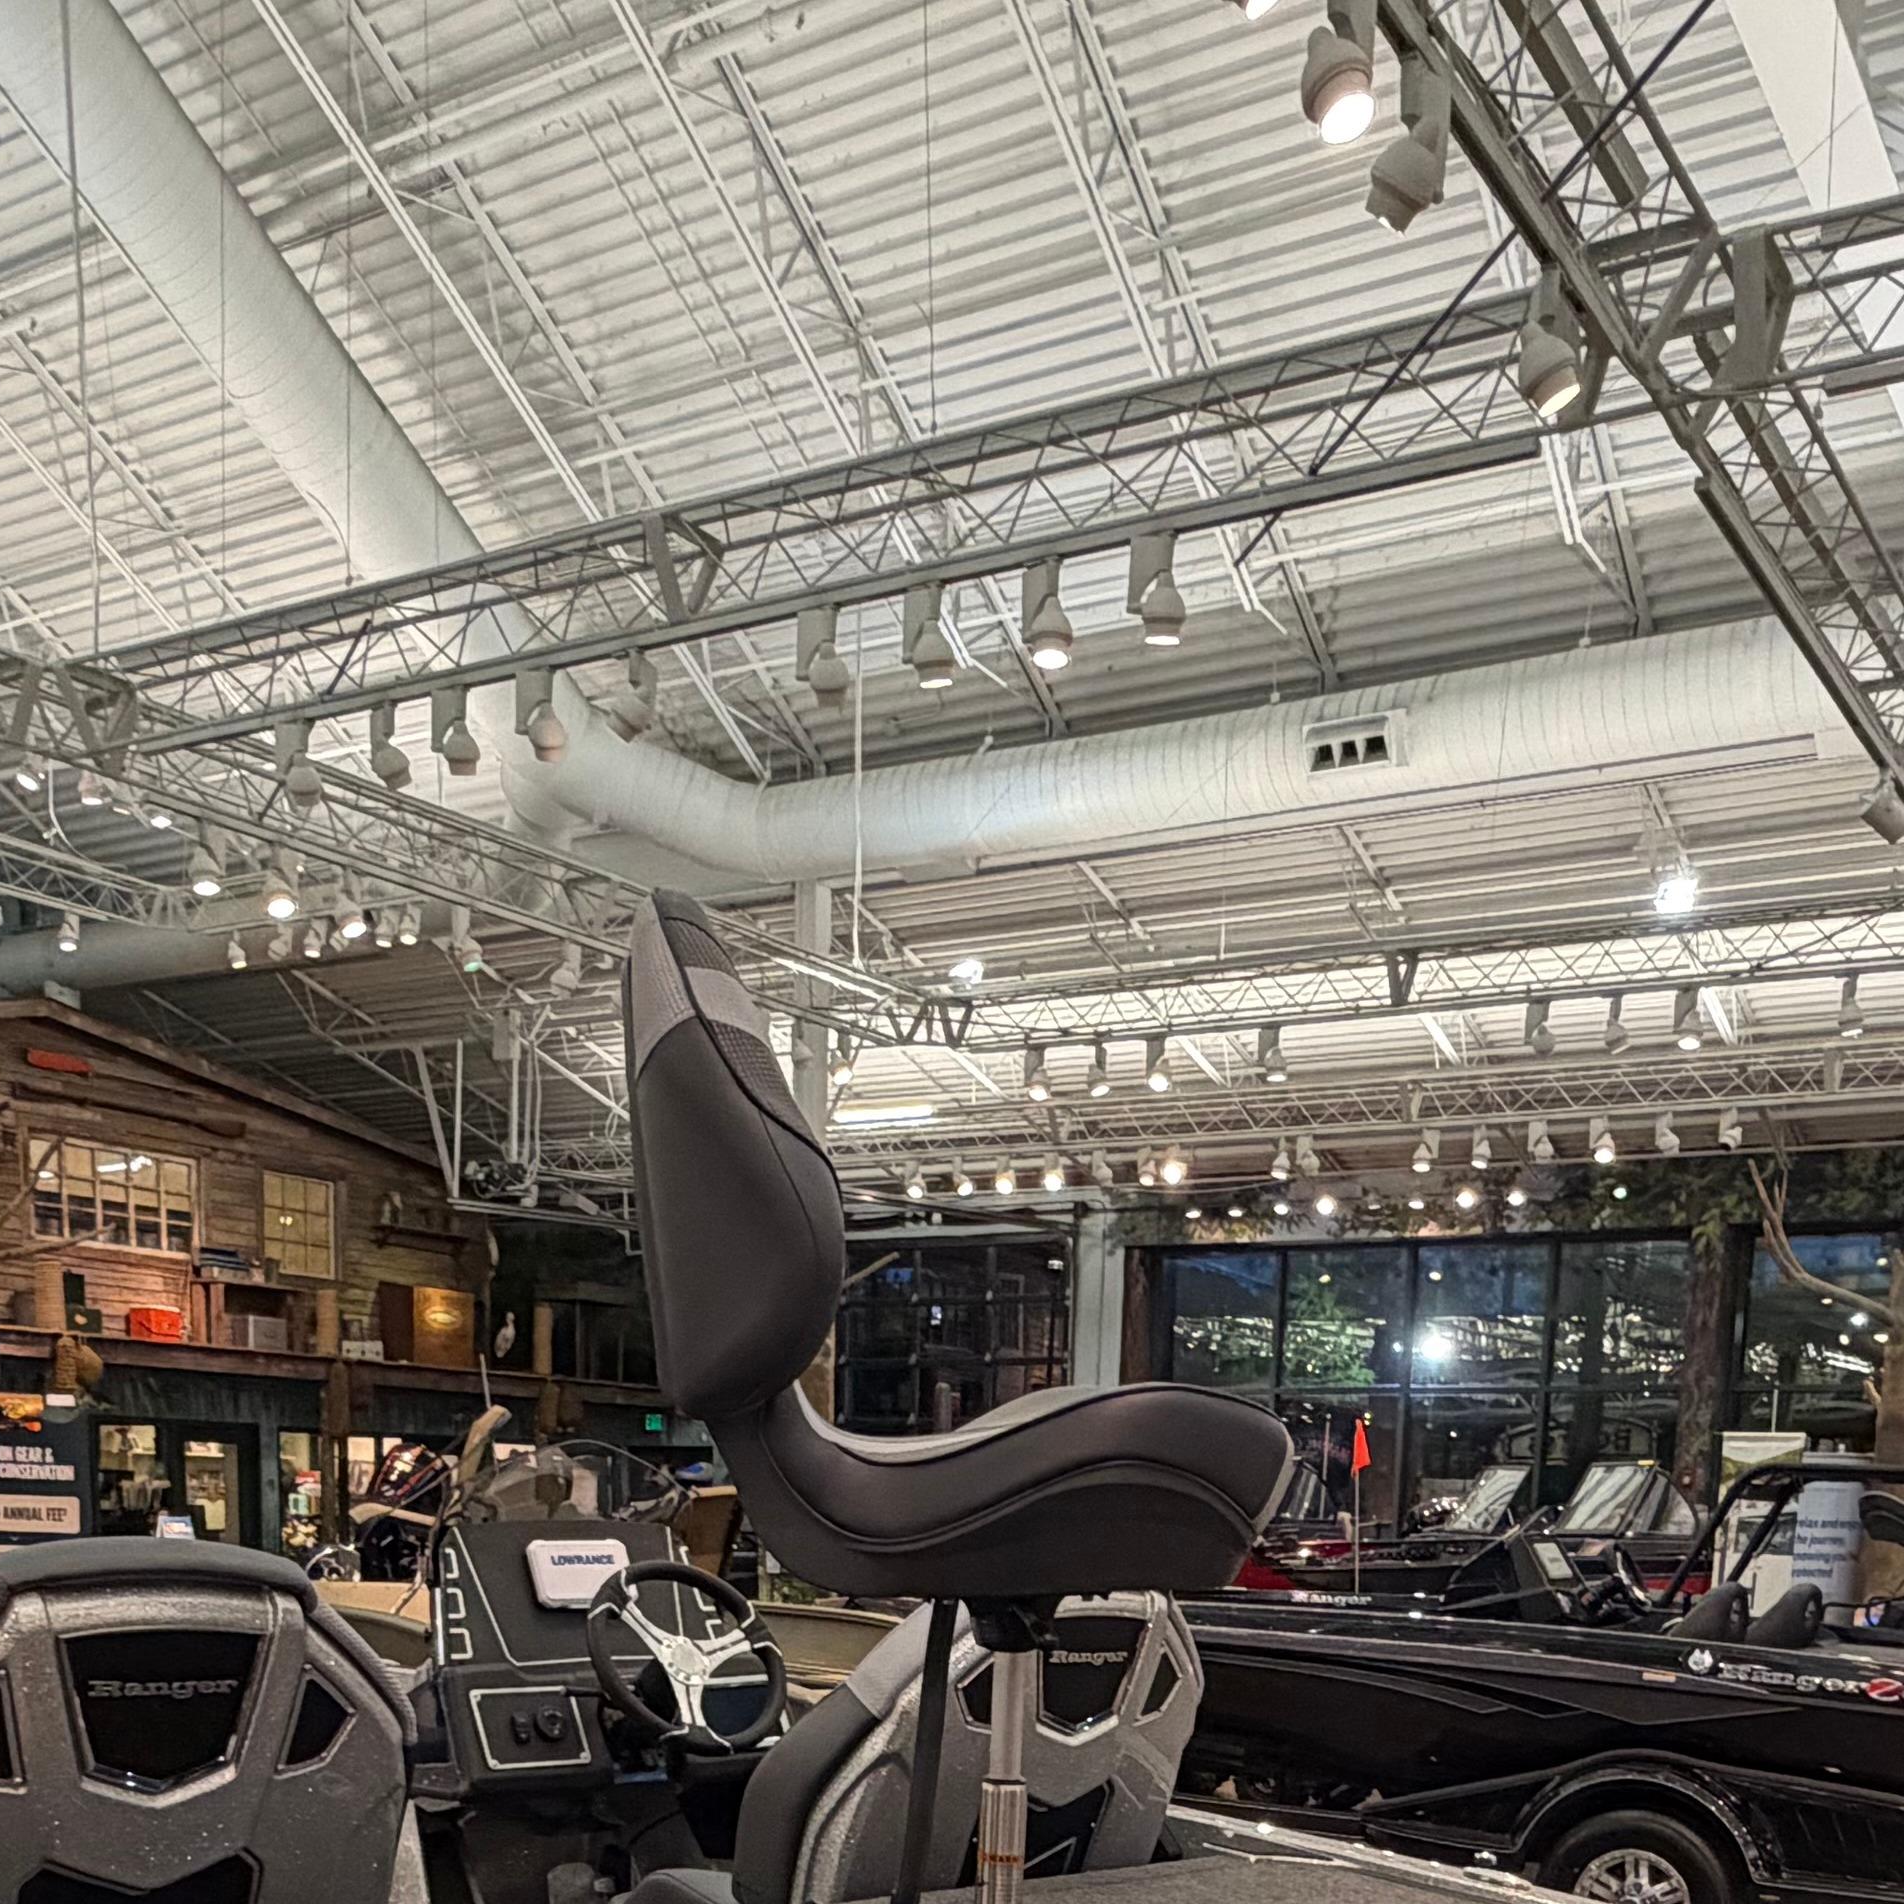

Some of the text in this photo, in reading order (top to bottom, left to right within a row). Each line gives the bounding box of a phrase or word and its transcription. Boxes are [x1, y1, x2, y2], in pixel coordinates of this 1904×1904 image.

[3, 1507, 43, 1521] ANNUAL
[550, 1554, 615, 1566] LOWRANCE
[1048, 1649, 1128, 1666] Ranger
[87, 1679, 239, 1699] Ranger
